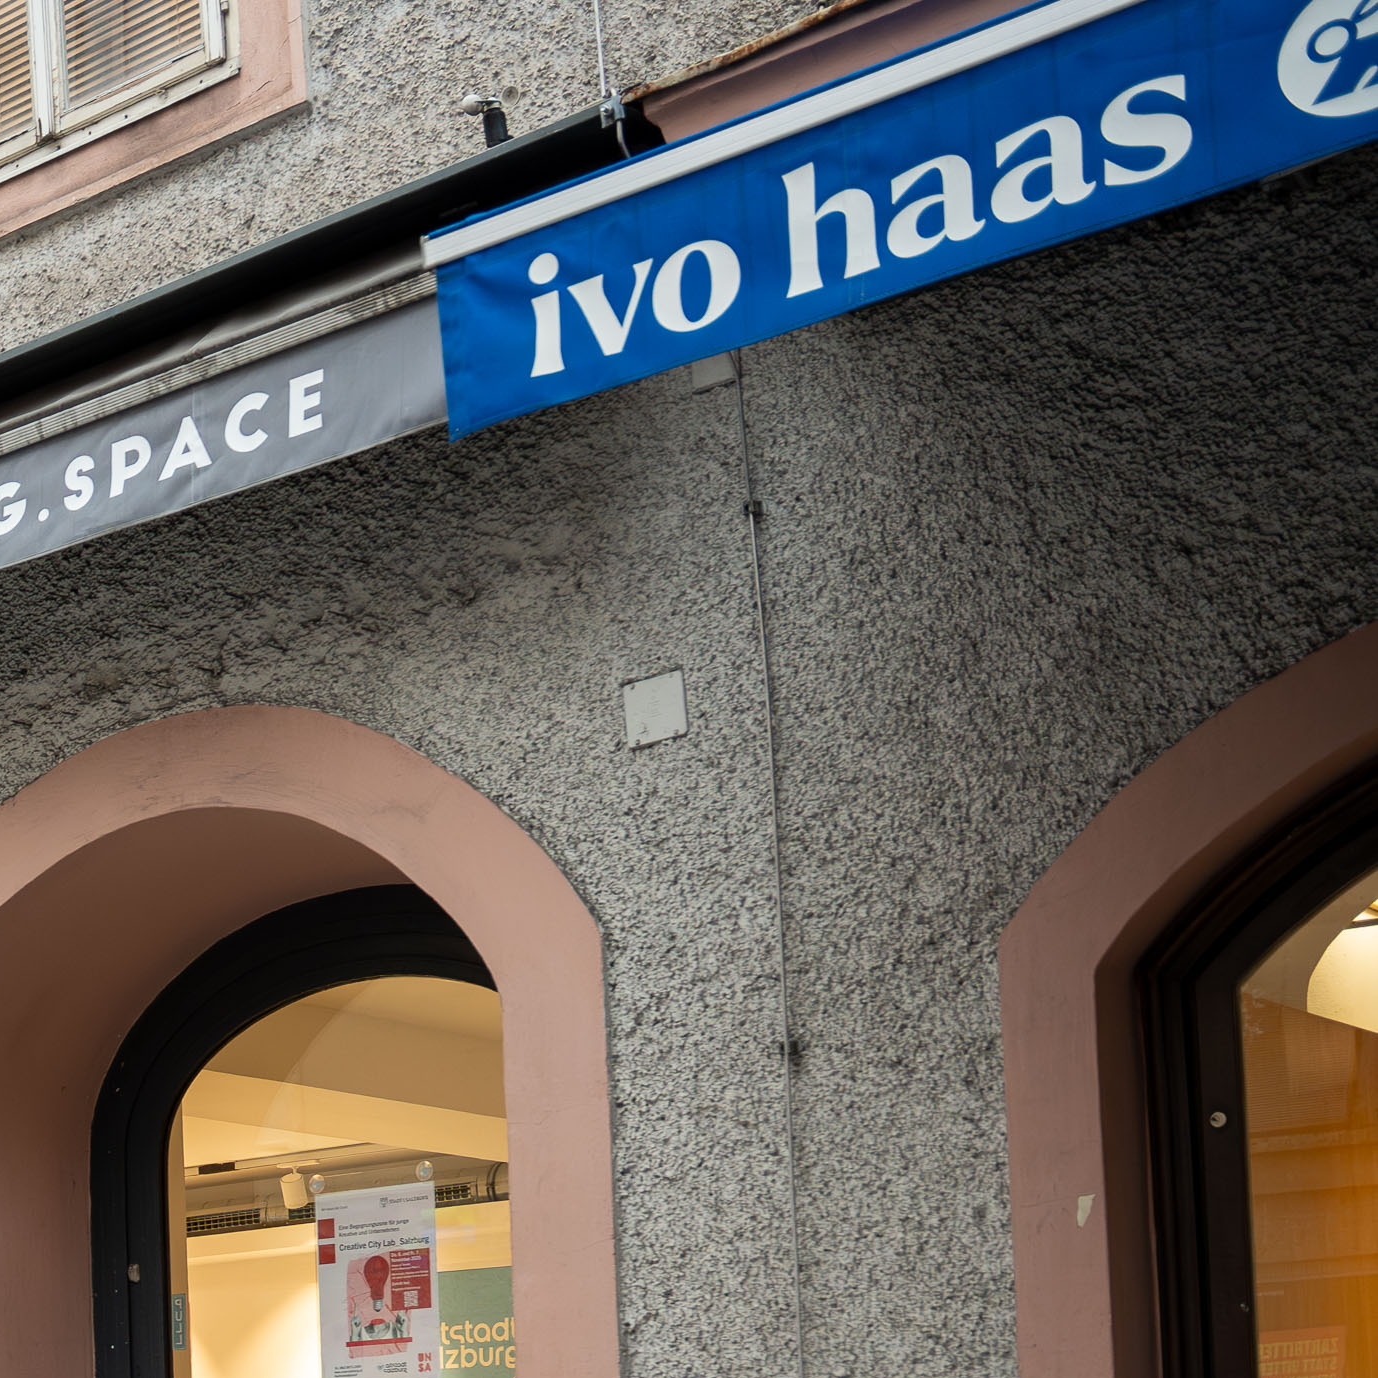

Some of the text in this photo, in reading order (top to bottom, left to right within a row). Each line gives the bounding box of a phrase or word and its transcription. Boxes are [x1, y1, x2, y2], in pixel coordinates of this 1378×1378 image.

[527, 74, 1194, 378] ivo haas
[339, 1241, 367, 1252] Creative
[368, 1240, 383, 1249] City
[418, 1363, 432, 1373] SA
